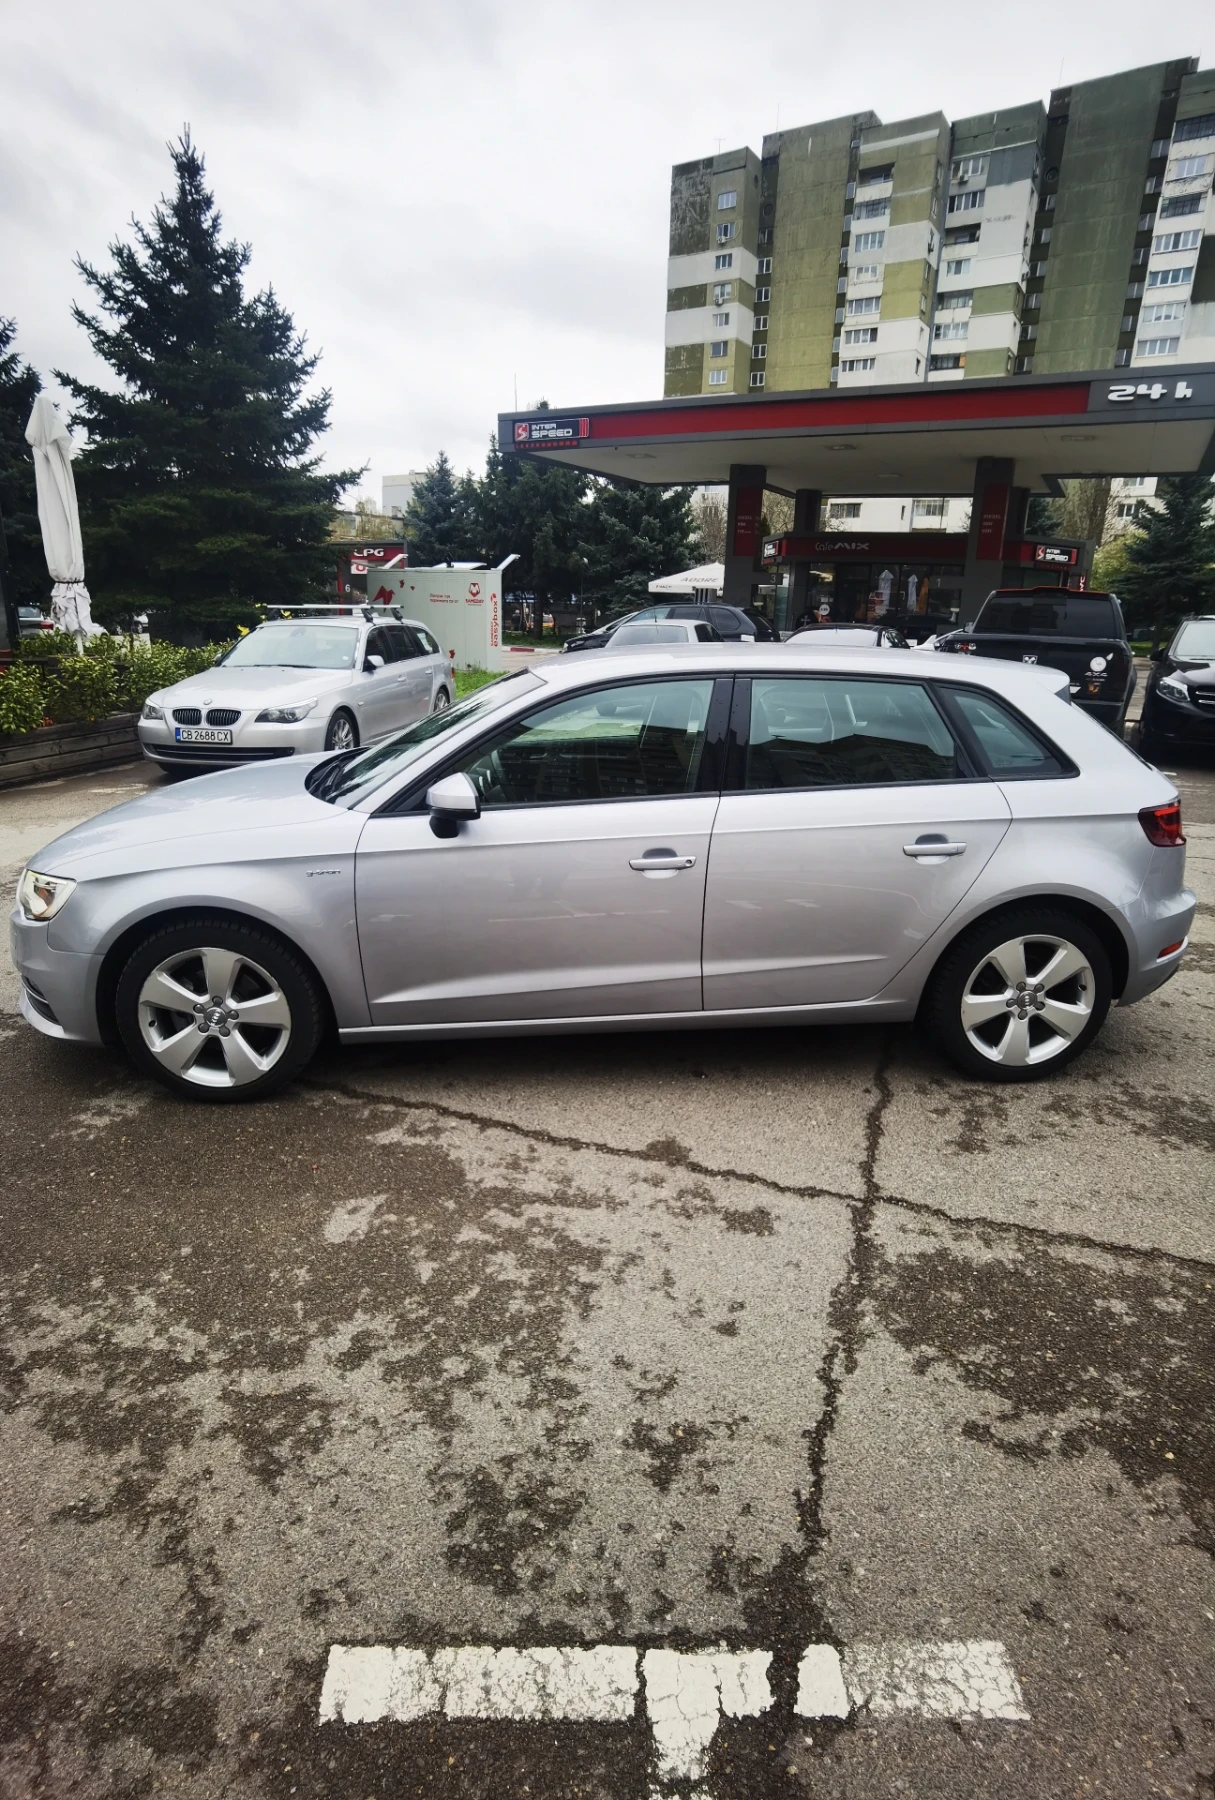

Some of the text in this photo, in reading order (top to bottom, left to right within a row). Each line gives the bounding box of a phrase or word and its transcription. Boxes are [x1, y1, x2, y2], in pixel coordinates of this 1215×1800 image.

[1107, 381, 1193, 401] 24 h
[531, 428, 573, 439] SPEED
[353, 548, 385, 557] LPG
[1045, 553, 1069, 562] SPEED
[770, 574, 777, 583] 3
[345, 583, 351, 593] 6
[181, 729, 229, 742] CB 2688 CX
